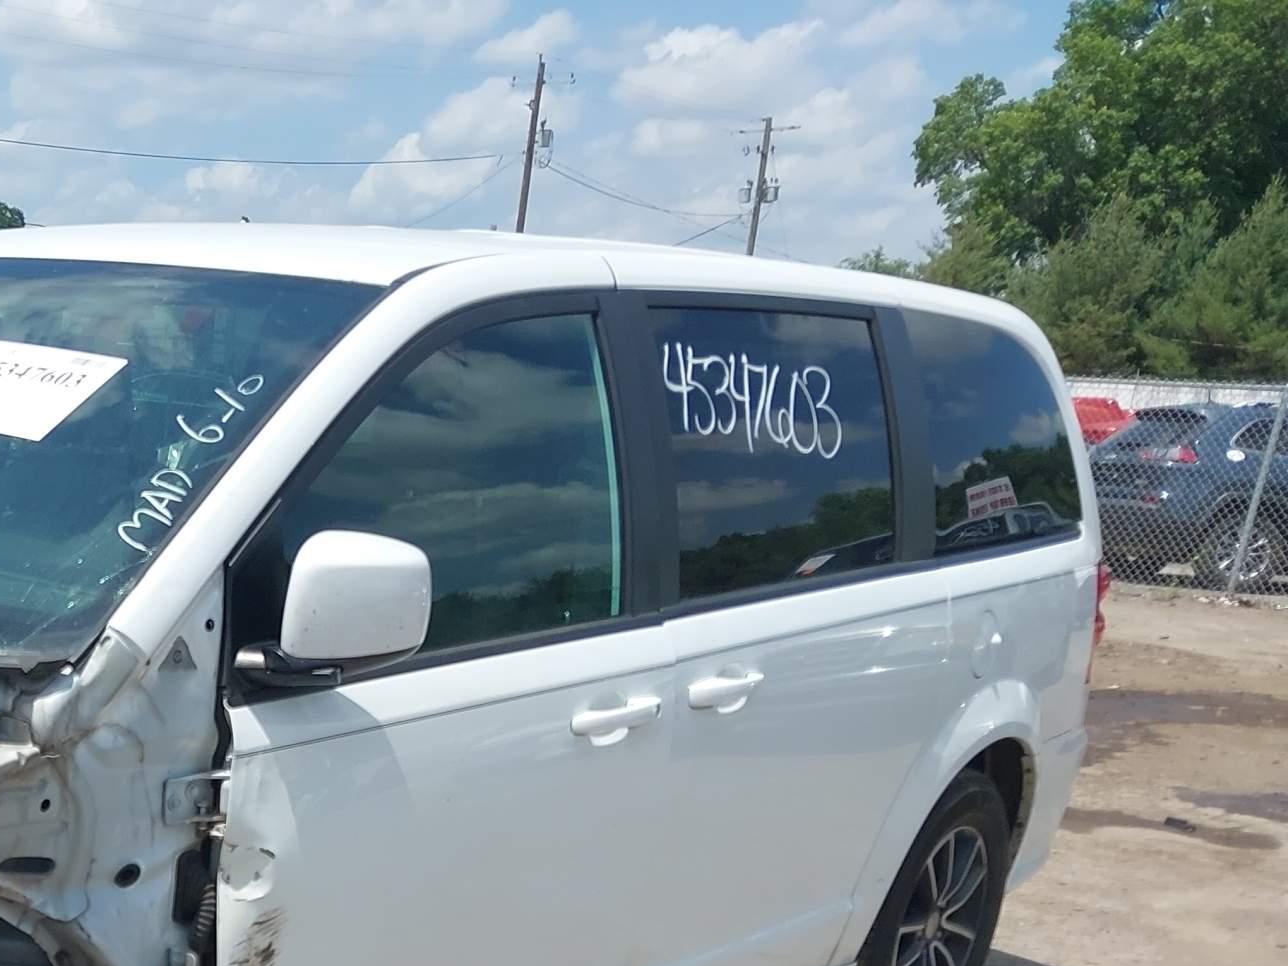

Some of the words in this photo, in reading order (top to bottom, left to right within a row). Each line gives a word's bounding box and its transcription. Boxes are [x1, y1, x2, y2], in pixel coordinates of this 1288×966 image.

[117, 467, 193, 552] MAD
[176, 374, 264, 444] 6-10
[663, 341, 843, 459] 45347603
